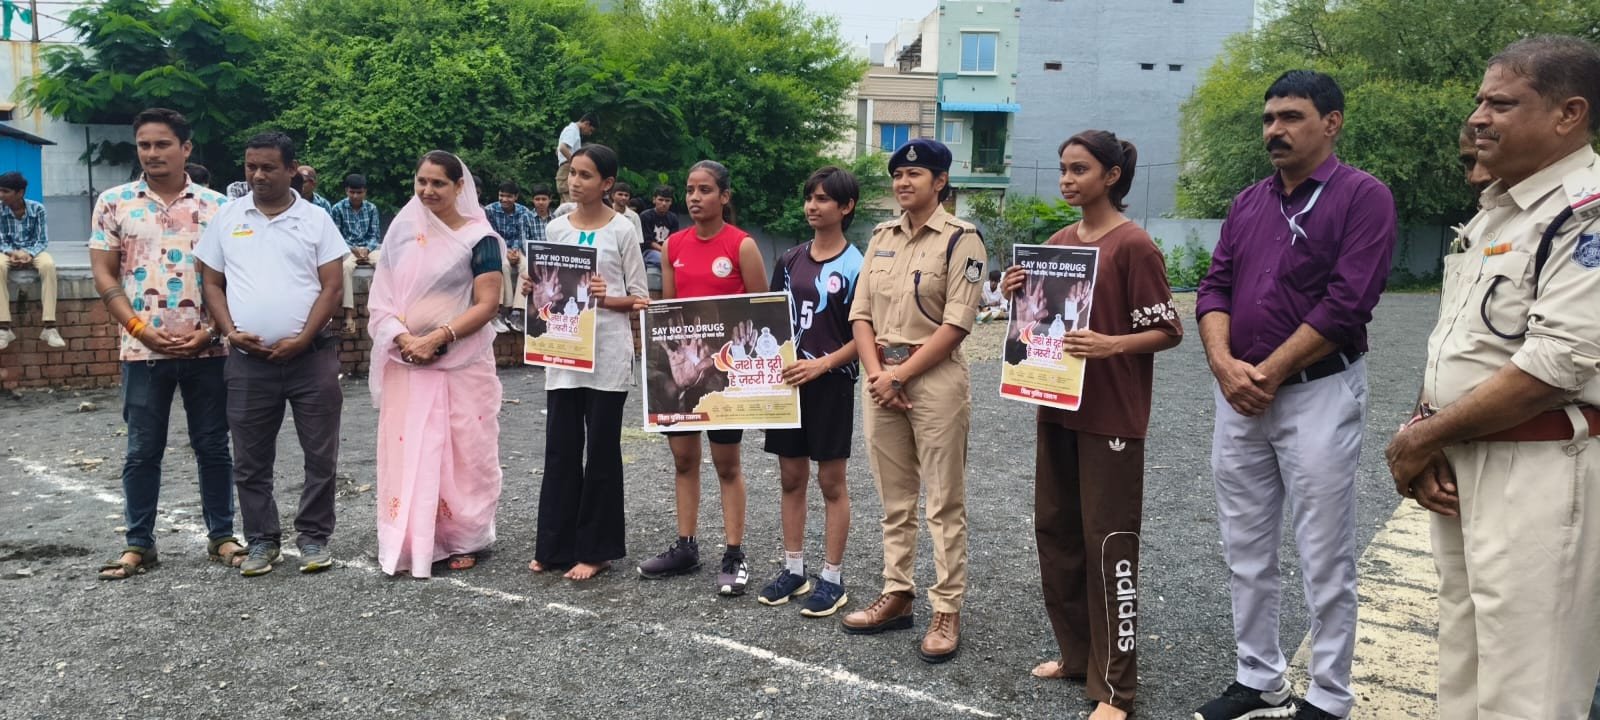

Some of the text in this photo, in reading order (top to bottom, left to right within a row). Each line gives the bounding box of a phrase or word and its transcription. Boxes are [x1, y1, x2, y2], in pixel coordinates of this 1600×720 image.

[570, 257, 591, 265] DRUGS
[1021, 260, 1087, 272] SAY NO TO DRUGS
[800, 300, 813, 329] 5
[652, 326, 667, 336] SAY
[669, 326, 681, 334] NO
[683, 324, 694, 333] TO
[696, 323, 725, 333] DRUGS
[768, 374, 783, 384] 2.0
[1115, 559, 1137, 652] adidas
